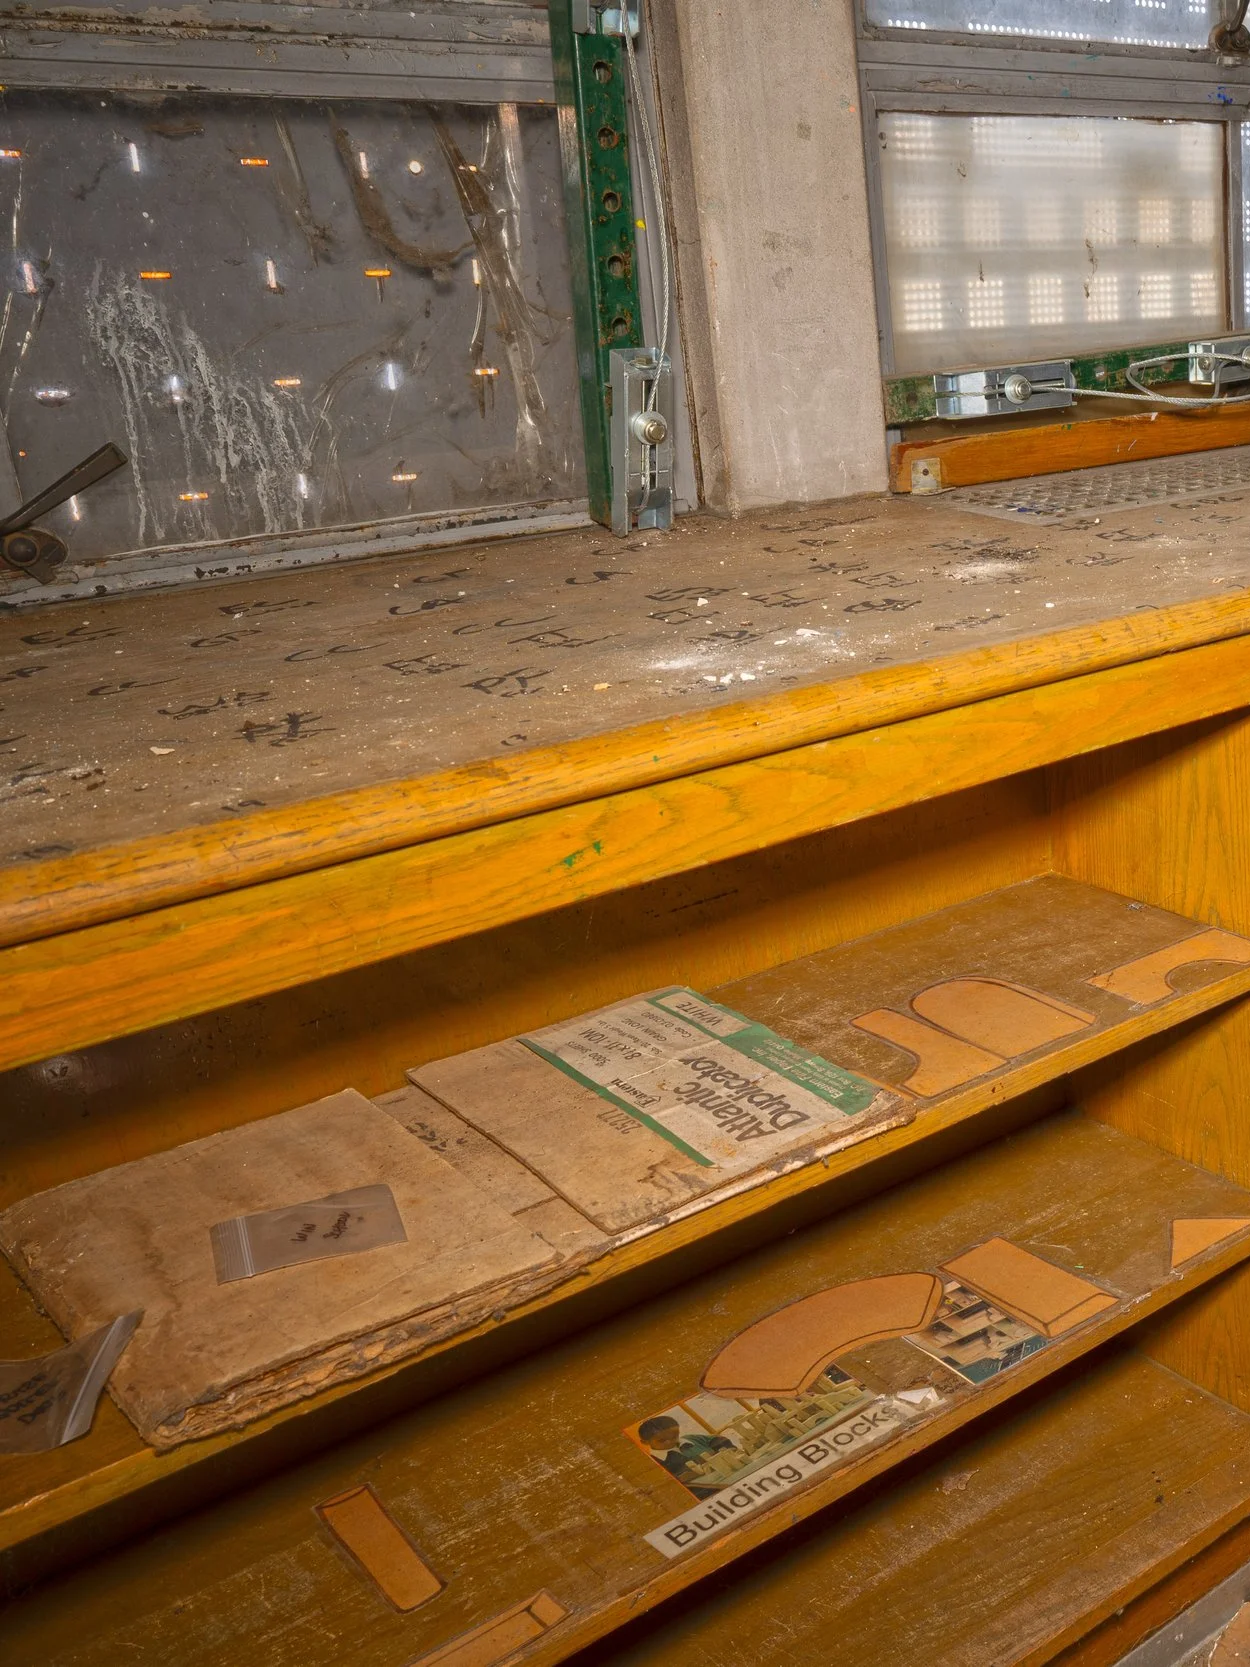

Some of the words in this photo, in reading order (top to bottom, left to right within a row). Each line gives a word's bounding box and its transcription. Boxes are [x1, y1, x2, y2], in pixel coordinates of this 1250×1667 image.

[675, 1002, 725, 1025] WHITE
[673, 1081, 776, 1142] Atlantic
[678, 1056, 812, 1131] Duplicator
[664, 1464, 803, 1548] Building
[798, 1404, 900, 1465] Blocks
